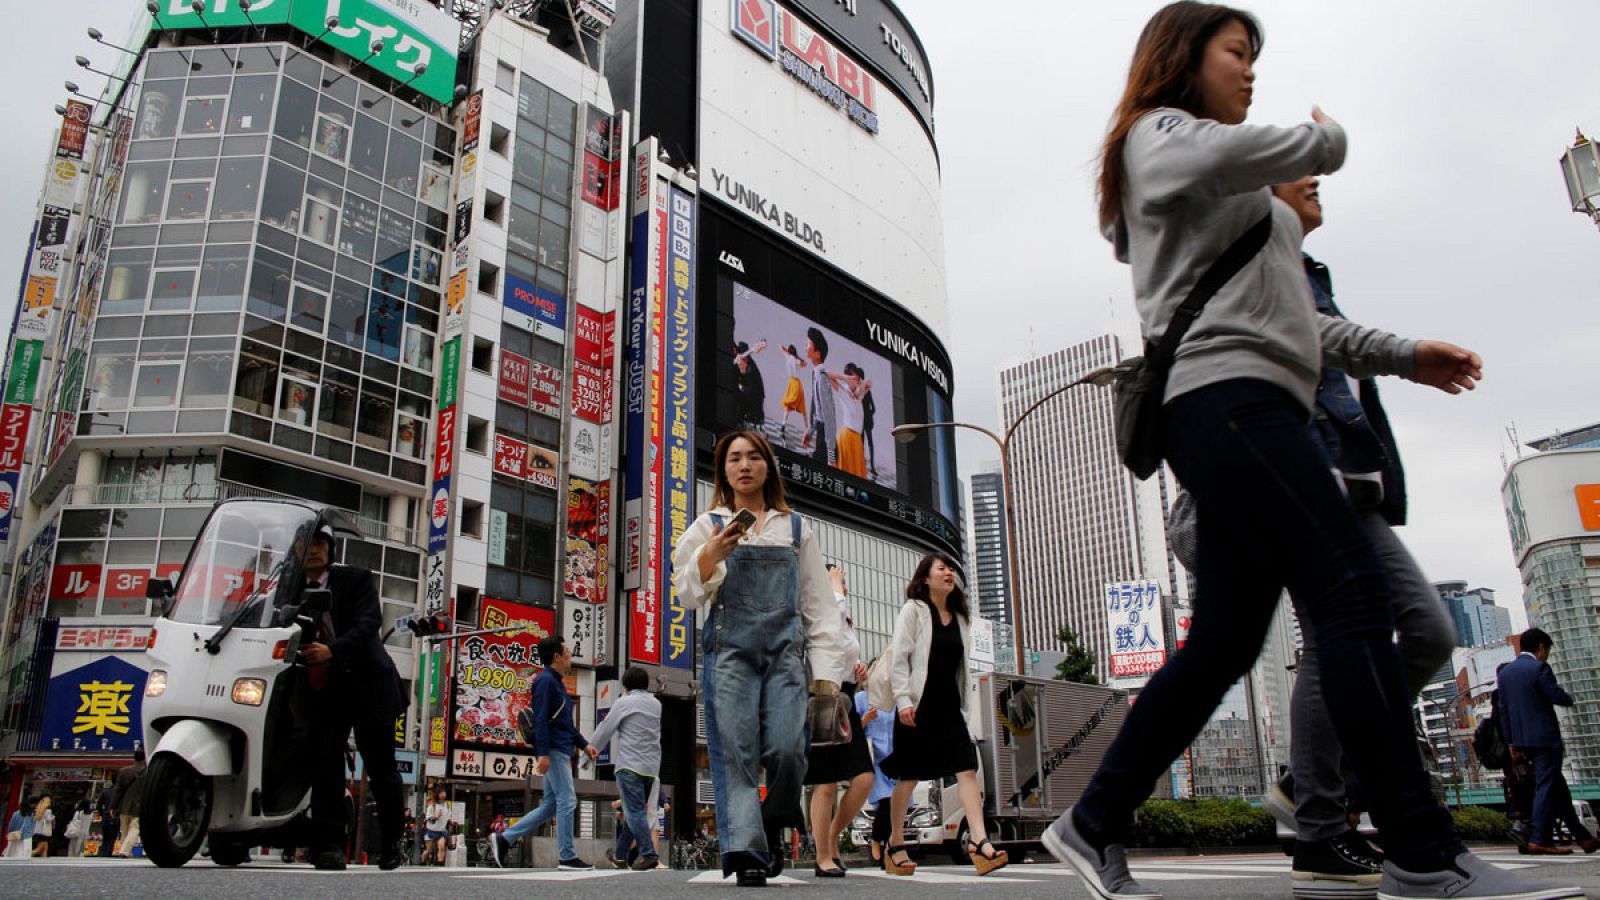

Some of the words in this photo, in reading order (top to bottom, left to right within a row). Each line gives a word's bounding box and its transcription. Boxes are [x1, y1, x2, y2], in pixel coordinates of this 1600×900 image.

[781, 10, 874, 108] LABI
[711, 167, 781, 226] YUNIKA
[783, 211, 827, 253] BLDG.
[514, 287, 557, 313] PROMISE
[526, 318, 543, 333] 7F
[577, 314, 600, 332] FAST
[577, 327, 600, 345] NAIL
[503, 358, 528, 374] FAST
[866, 319, 920, 366] YUNIKA
[919, 351, 949, 395] VISION
[503, 370, 526, 385] NAIL
[5, 408, 25, 467] アイフル
[438, 411, 452, 474] アイフル
[64, 571, 90, 594] ル
[116, 574, 144, 590] 3F
[1108, 583, 1158, 610] カラオケ
[1128, 609, 1140, 625] の
[1115, 623, 1158, 650] 鉄人
[72, 680, 135, 735] 薬
